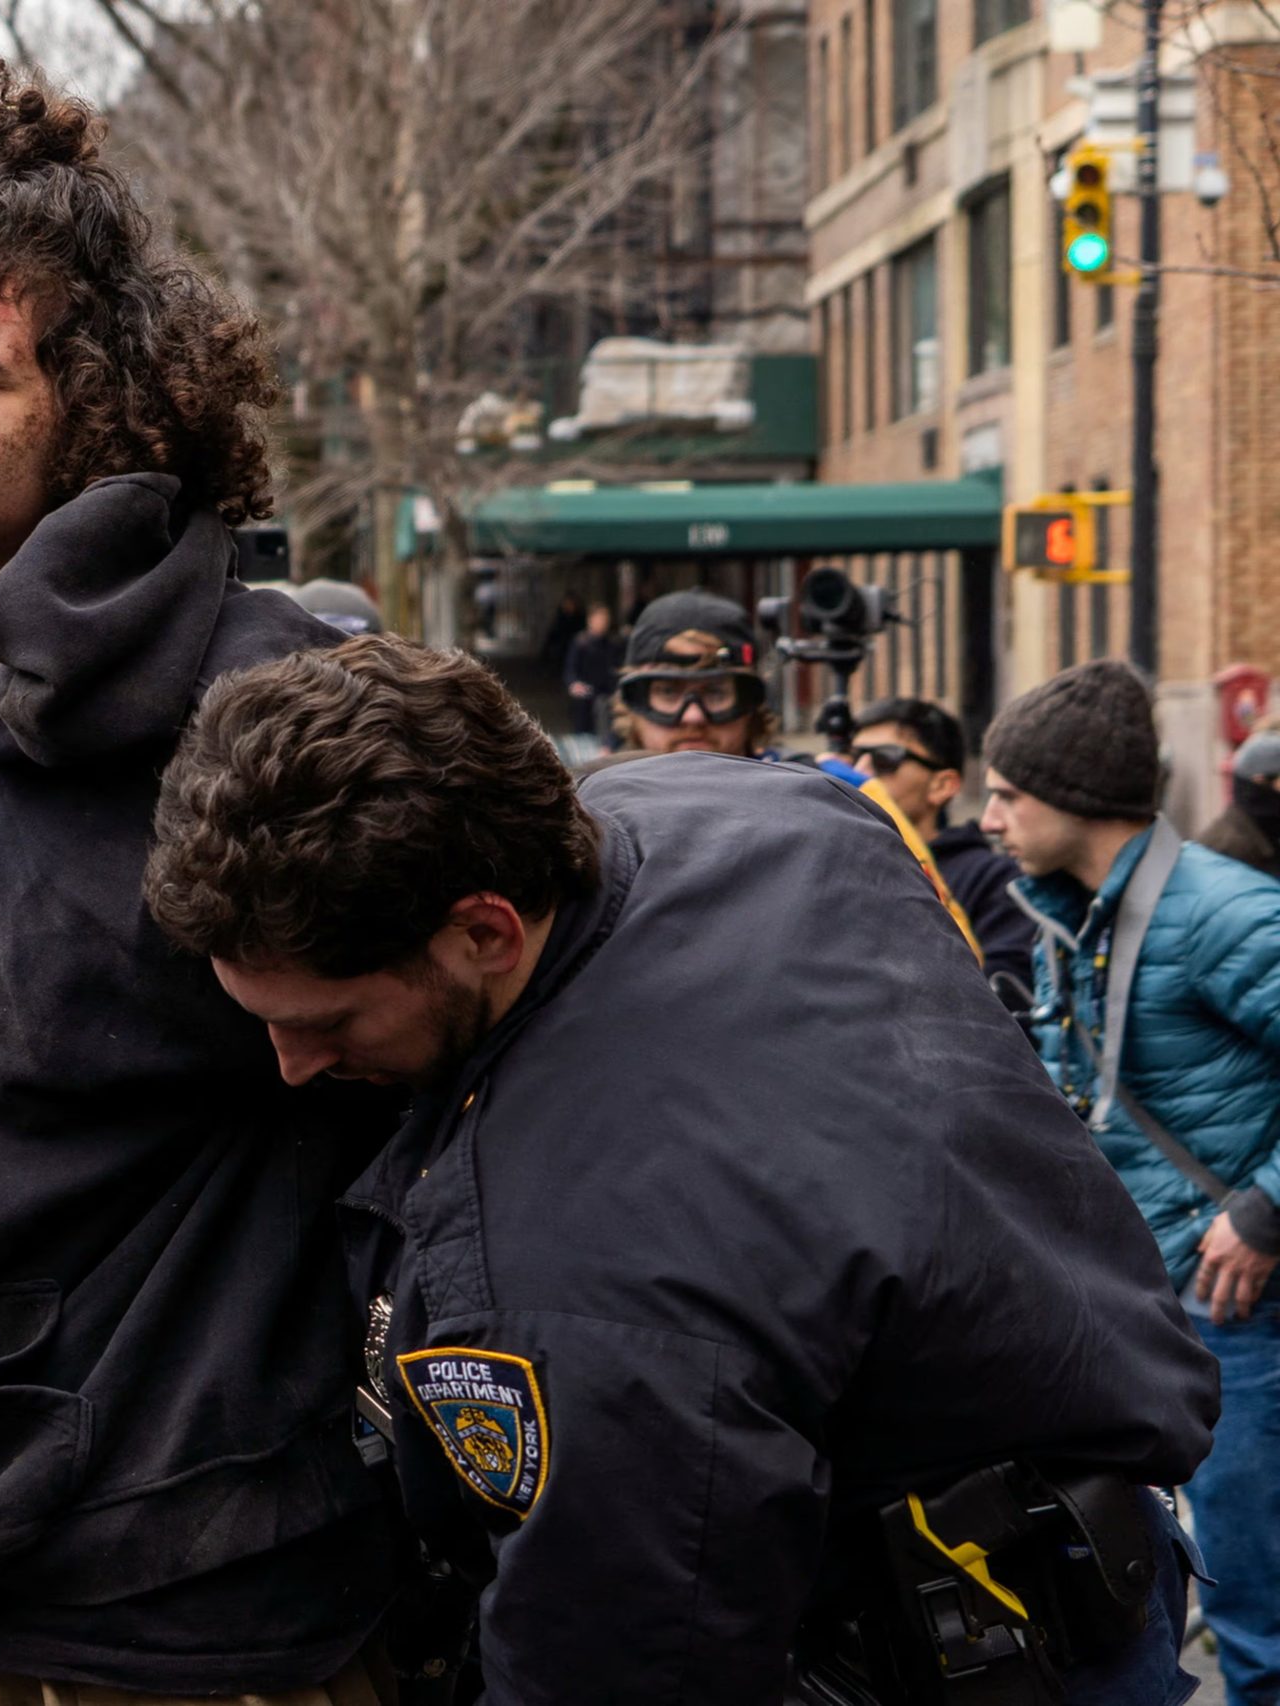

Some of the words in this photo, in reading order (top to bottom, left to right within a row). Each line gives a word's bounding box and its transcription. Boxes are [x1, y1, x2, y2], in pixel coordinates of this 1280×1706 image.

[428, 1361, 493, 1383] POLICE
[417, 1382, 523, 1408] DEPARTMENT
[435, 1423, 468, 1466] CITY
[468, 1470, 493, 1495] OF
[523, 1419, 539, 1470] YORK
[515, 1471, 535, 1504] NEW
